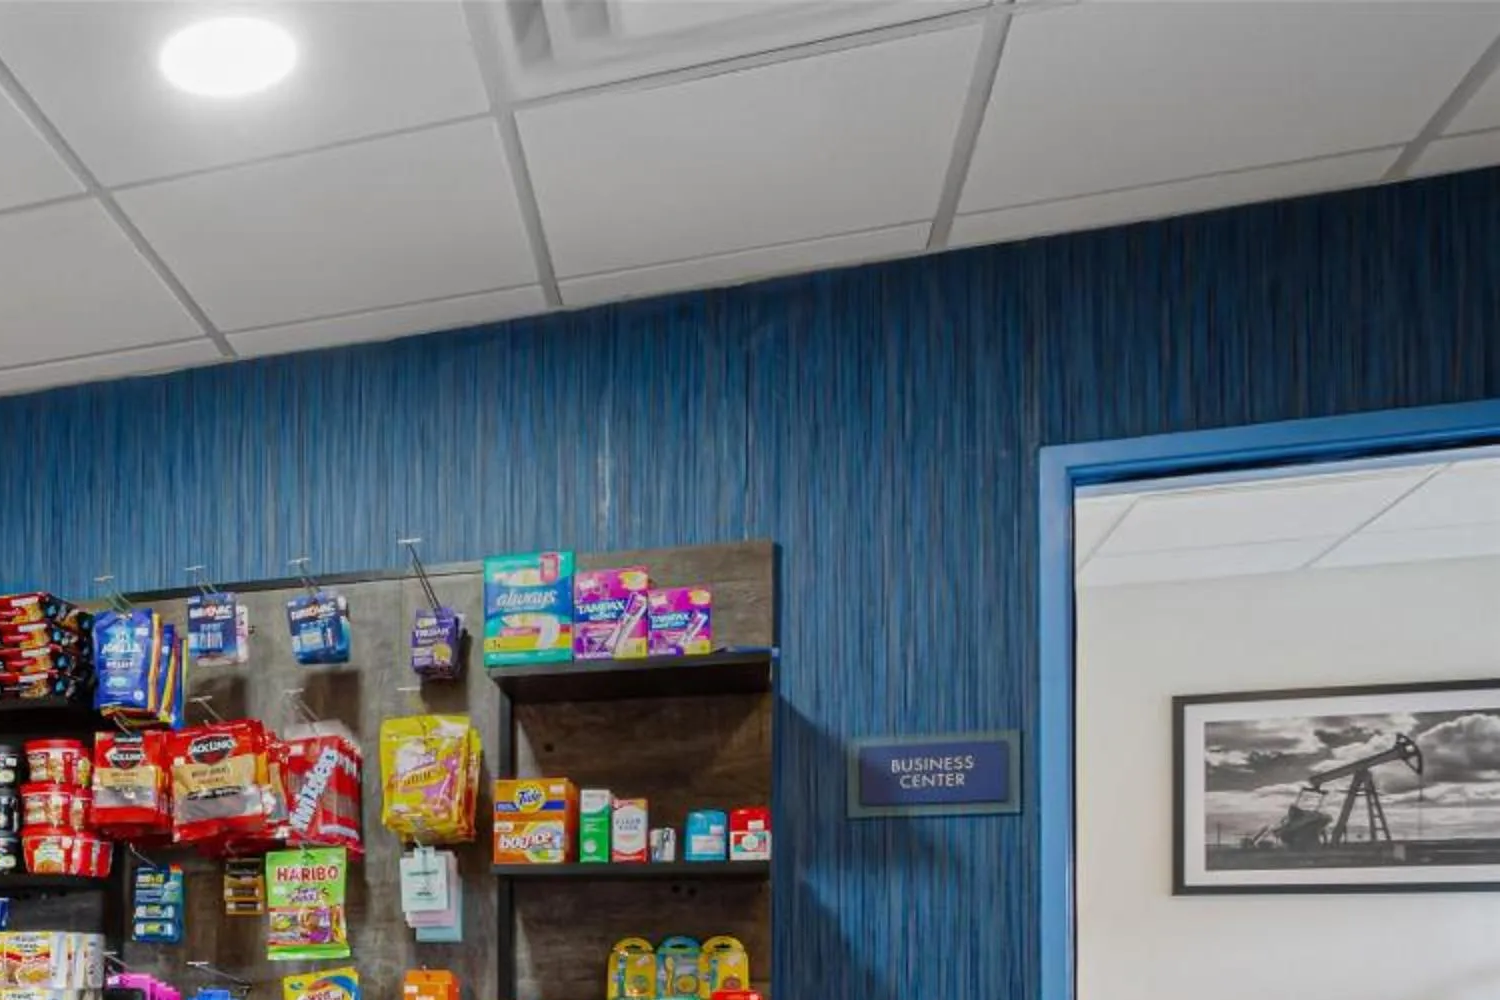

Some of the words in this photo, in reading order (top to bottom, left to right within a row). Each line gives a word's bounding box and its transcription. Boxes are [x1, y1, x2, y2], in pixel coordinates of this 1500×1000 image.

[496, 588, 558, 611] always
[890, 755, 975, 774] BUSINESS
[899, 773, 965, 790] CENTER
[276, 865, 340, 882] HARIBO
